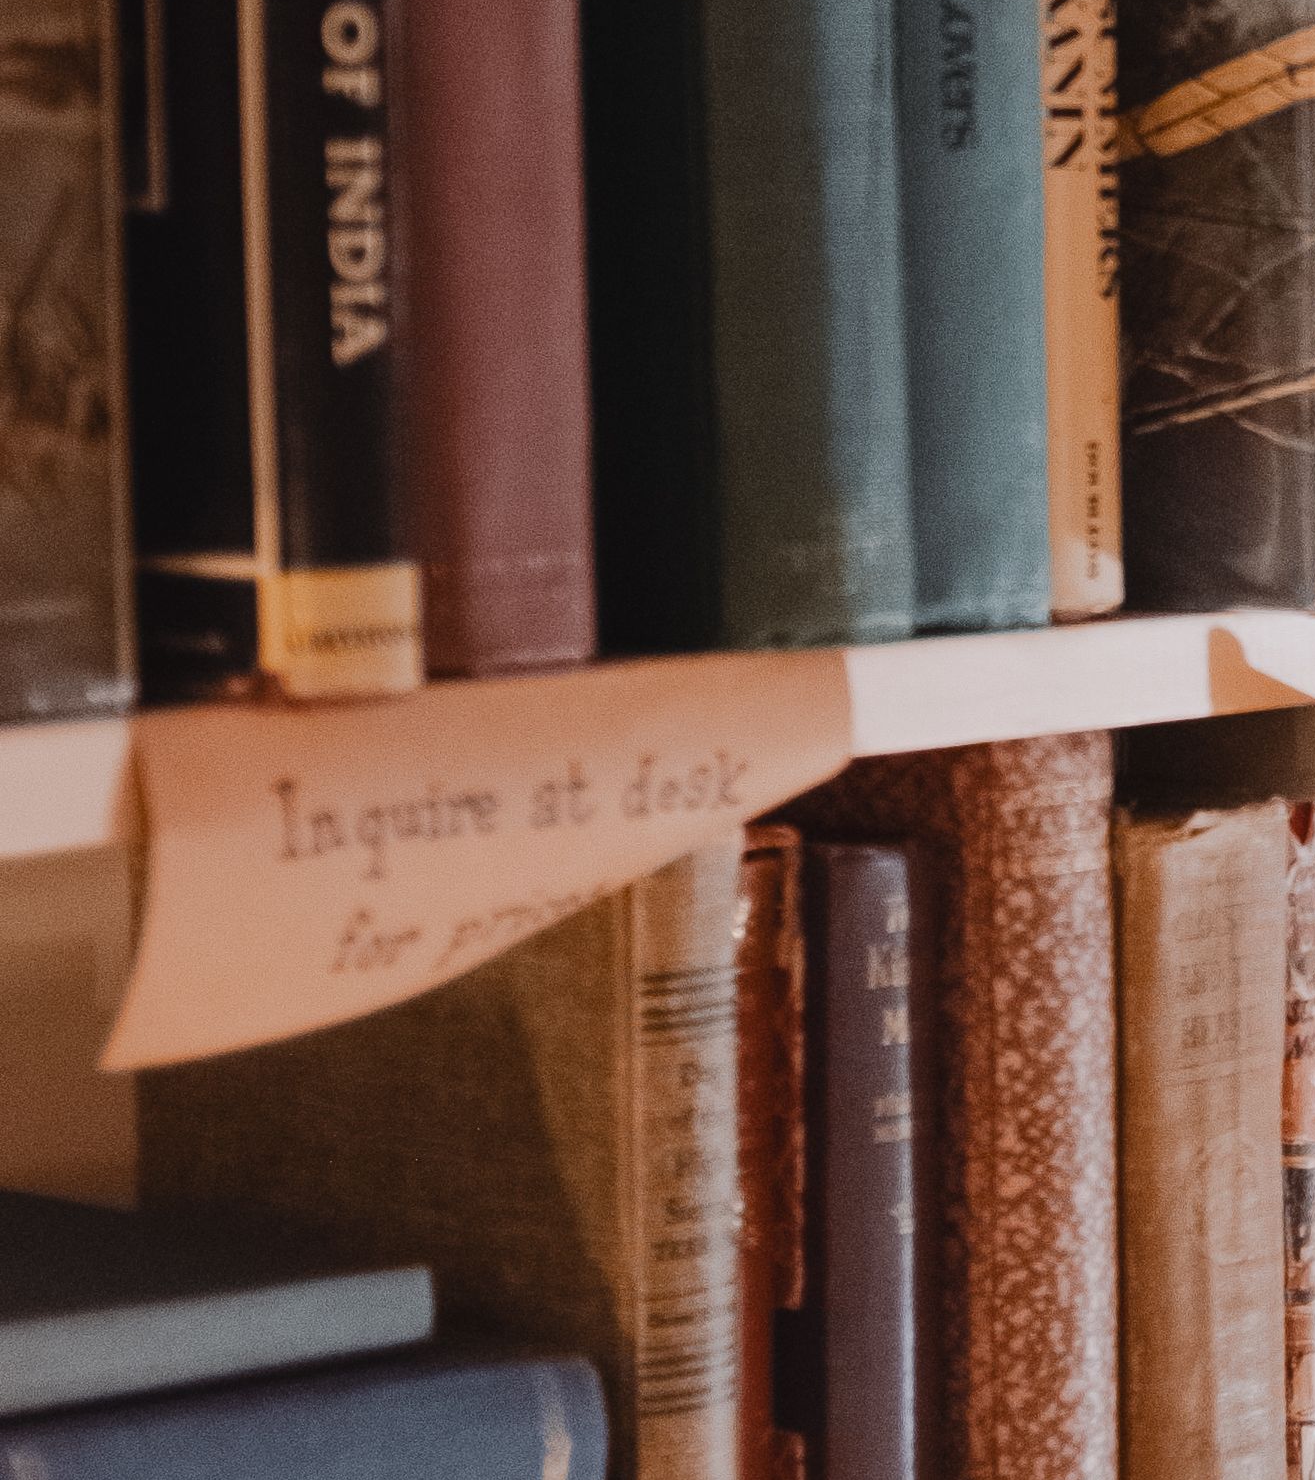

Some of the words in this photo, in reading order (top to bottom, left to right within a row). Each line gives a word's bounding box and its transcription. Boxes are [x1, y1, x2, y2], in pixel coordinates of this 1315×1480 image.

[319, 0, 379, 109] OF
[324, 135, 388, 369] INDIA
[272, 777, 498, 882] Inquire
[528, 757, 590, 831] at
[619, 751, 748, 820] desk
